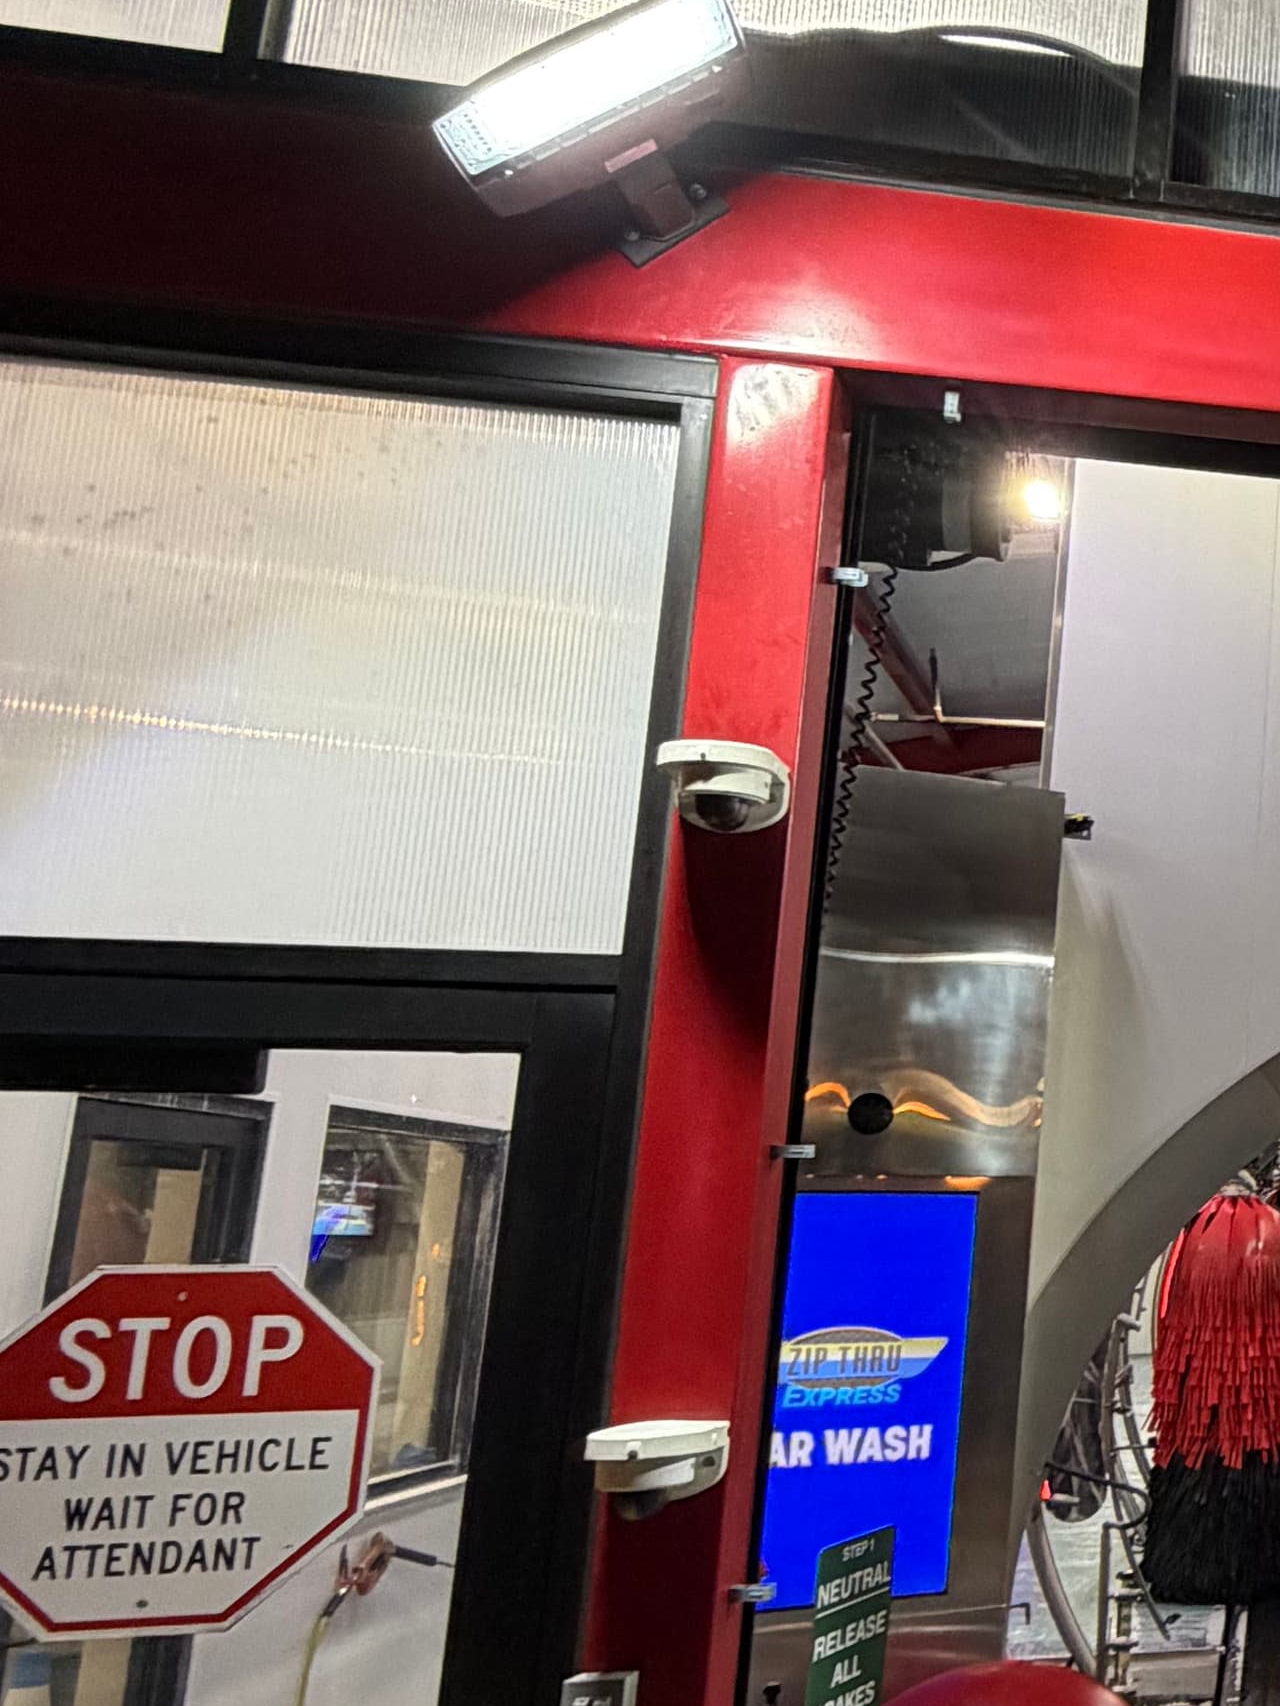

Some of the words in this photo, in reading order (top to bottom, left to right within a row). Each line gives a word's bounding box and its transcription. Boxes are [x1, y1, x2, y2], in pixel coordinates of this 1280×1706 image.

[48, 1315, 304, 1403] STOP
[787, 1347, 829, 1377] ZIP
[838, 1343, 902, 1375] THRU
[781, 1384, 903, 1408] EXPRESS
[105, 1443, 146, 1479] IN
[165, 1436, 333, 1476] VEHICLE
[768, 1431, 815, 1469] AR
[824, 1423, 934, 1466] WASH
[64, 1495, 155, 1531] WAIT
[168, 1492, 246, 1527] FOR
[31, 1536, 262, 1581] ATTENDANT
[842, 1541, 869, 1561] STEP
[816, 1560, 892, 1609] NEUTRAL
[812, 1608, 888, 1663] RELEASE
[830, 1654, 863, 1688] ALL
